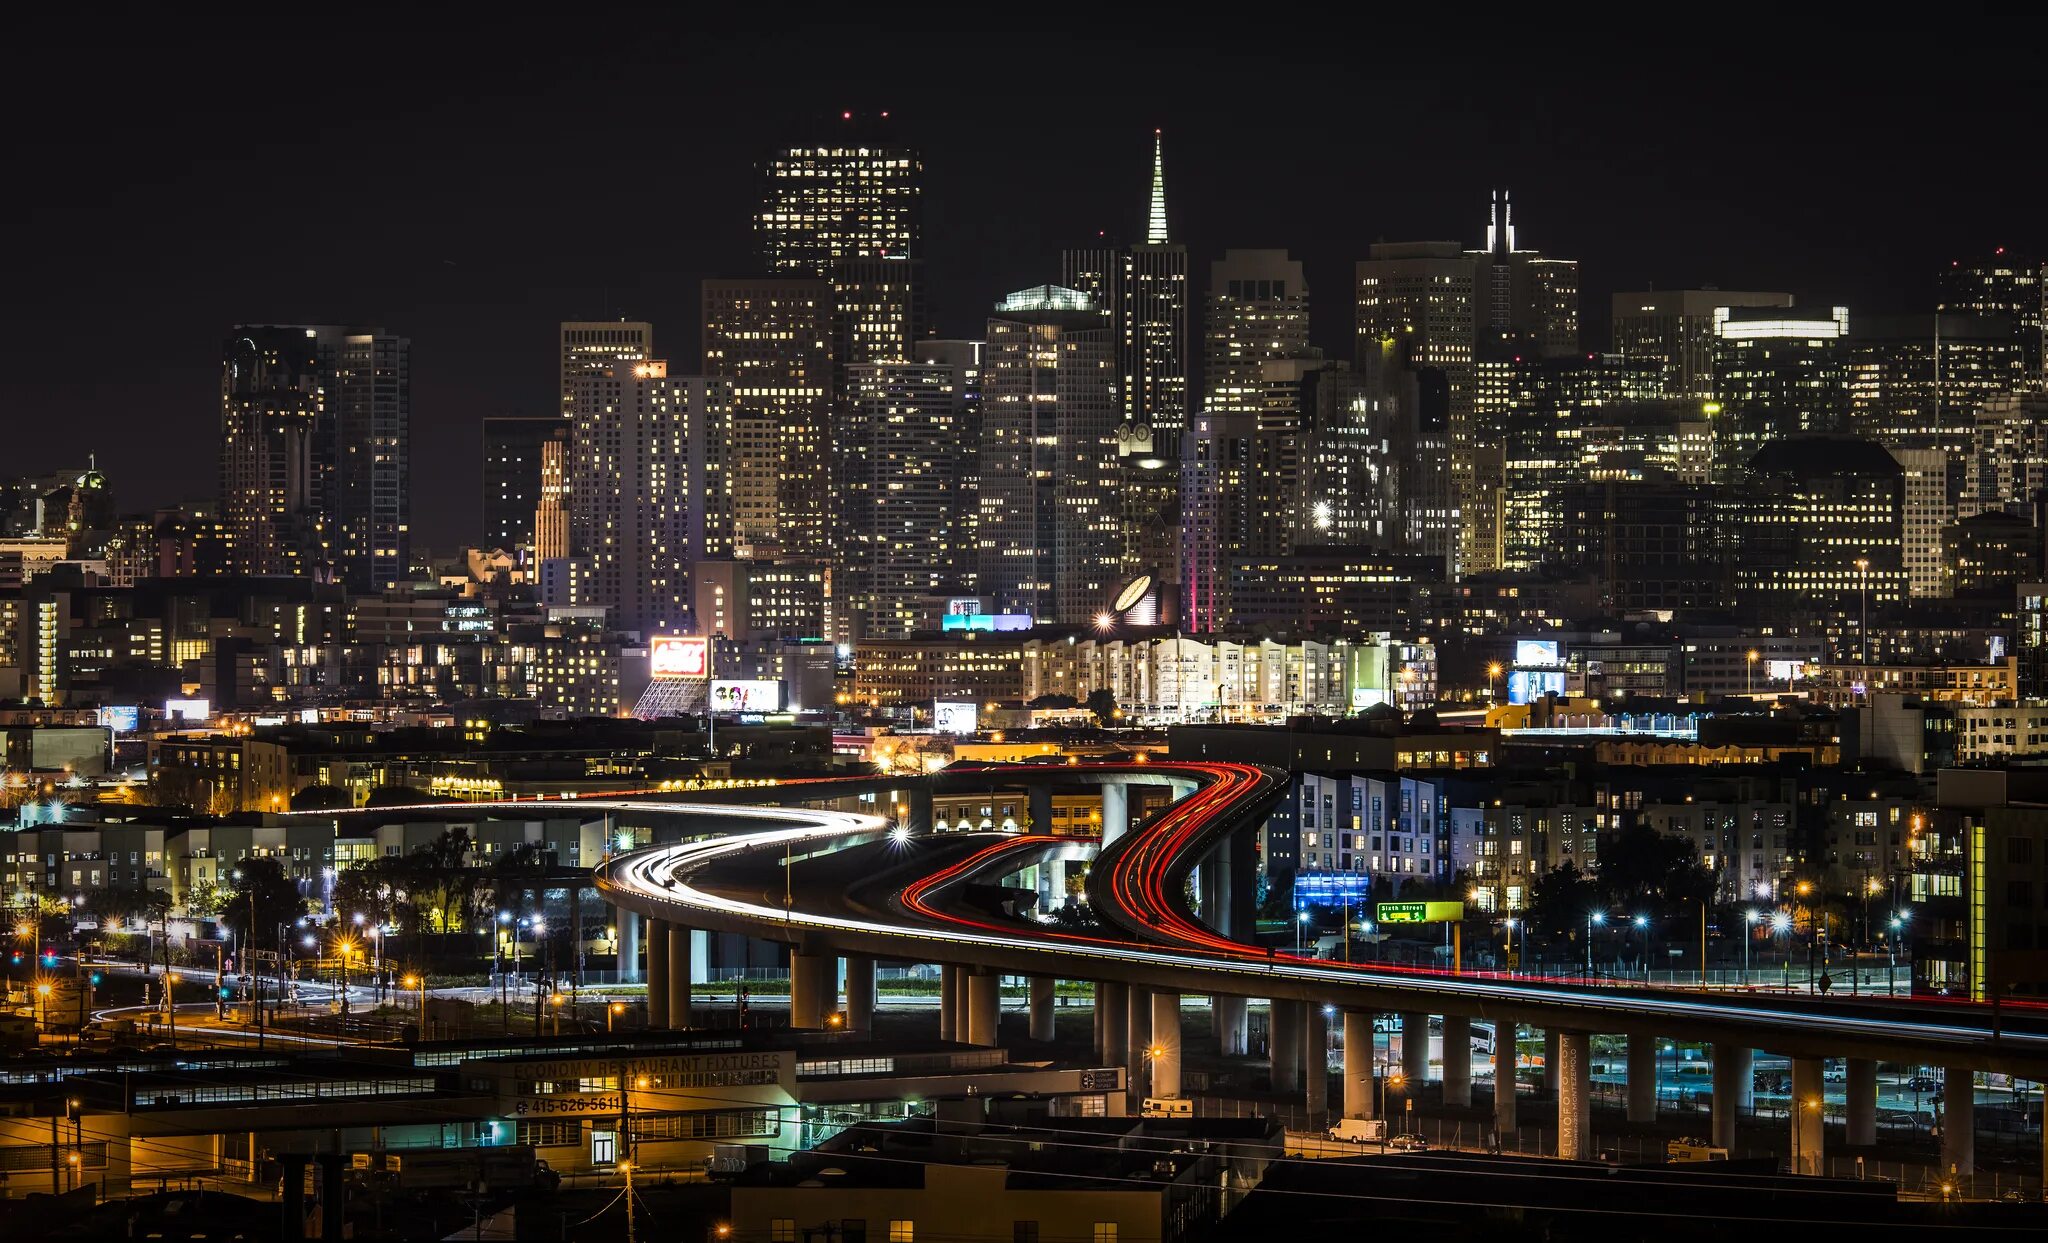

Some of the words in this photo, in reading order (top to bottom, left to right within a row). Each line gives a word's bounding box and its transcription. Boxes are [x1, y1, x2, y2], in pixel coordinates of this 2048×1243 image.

[514, 1062, 592, 1078] ECONOMY
[598, 1057, 700, 1076] RESTAURANT
[707, 1054, 781, 1071] FIXTURES
[532, 1096, 620, 1113] 415-626-5611
